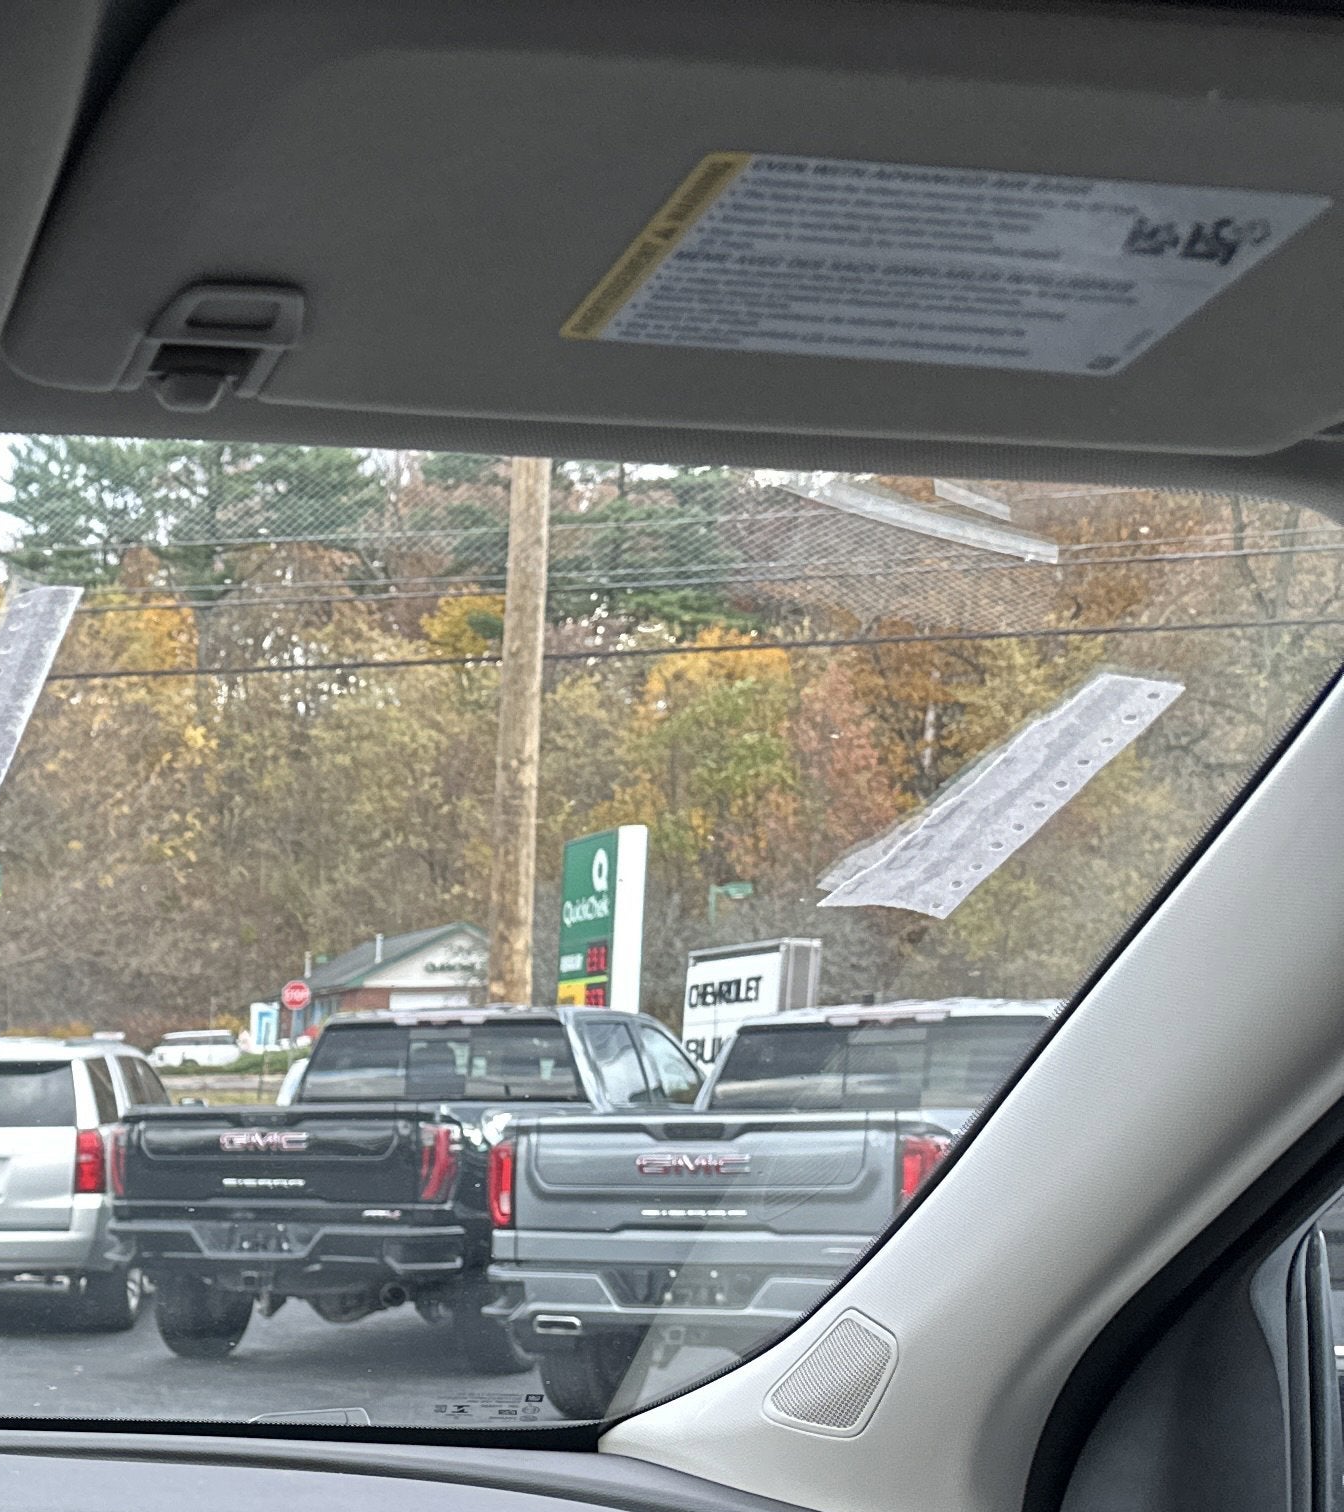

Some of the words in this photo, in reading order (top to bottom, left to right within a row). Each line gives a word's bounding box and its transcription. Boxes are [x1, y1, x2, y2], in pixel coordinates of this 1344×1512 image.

[284, 990, 309, 1001] STOP
[689, 976, 763, 1008] CHEVROLET
[686, 1037, 722, 1063] BUI
[220, 1132, 308, 1151] GMC
[635, 1154, 751, 1176] GMC
